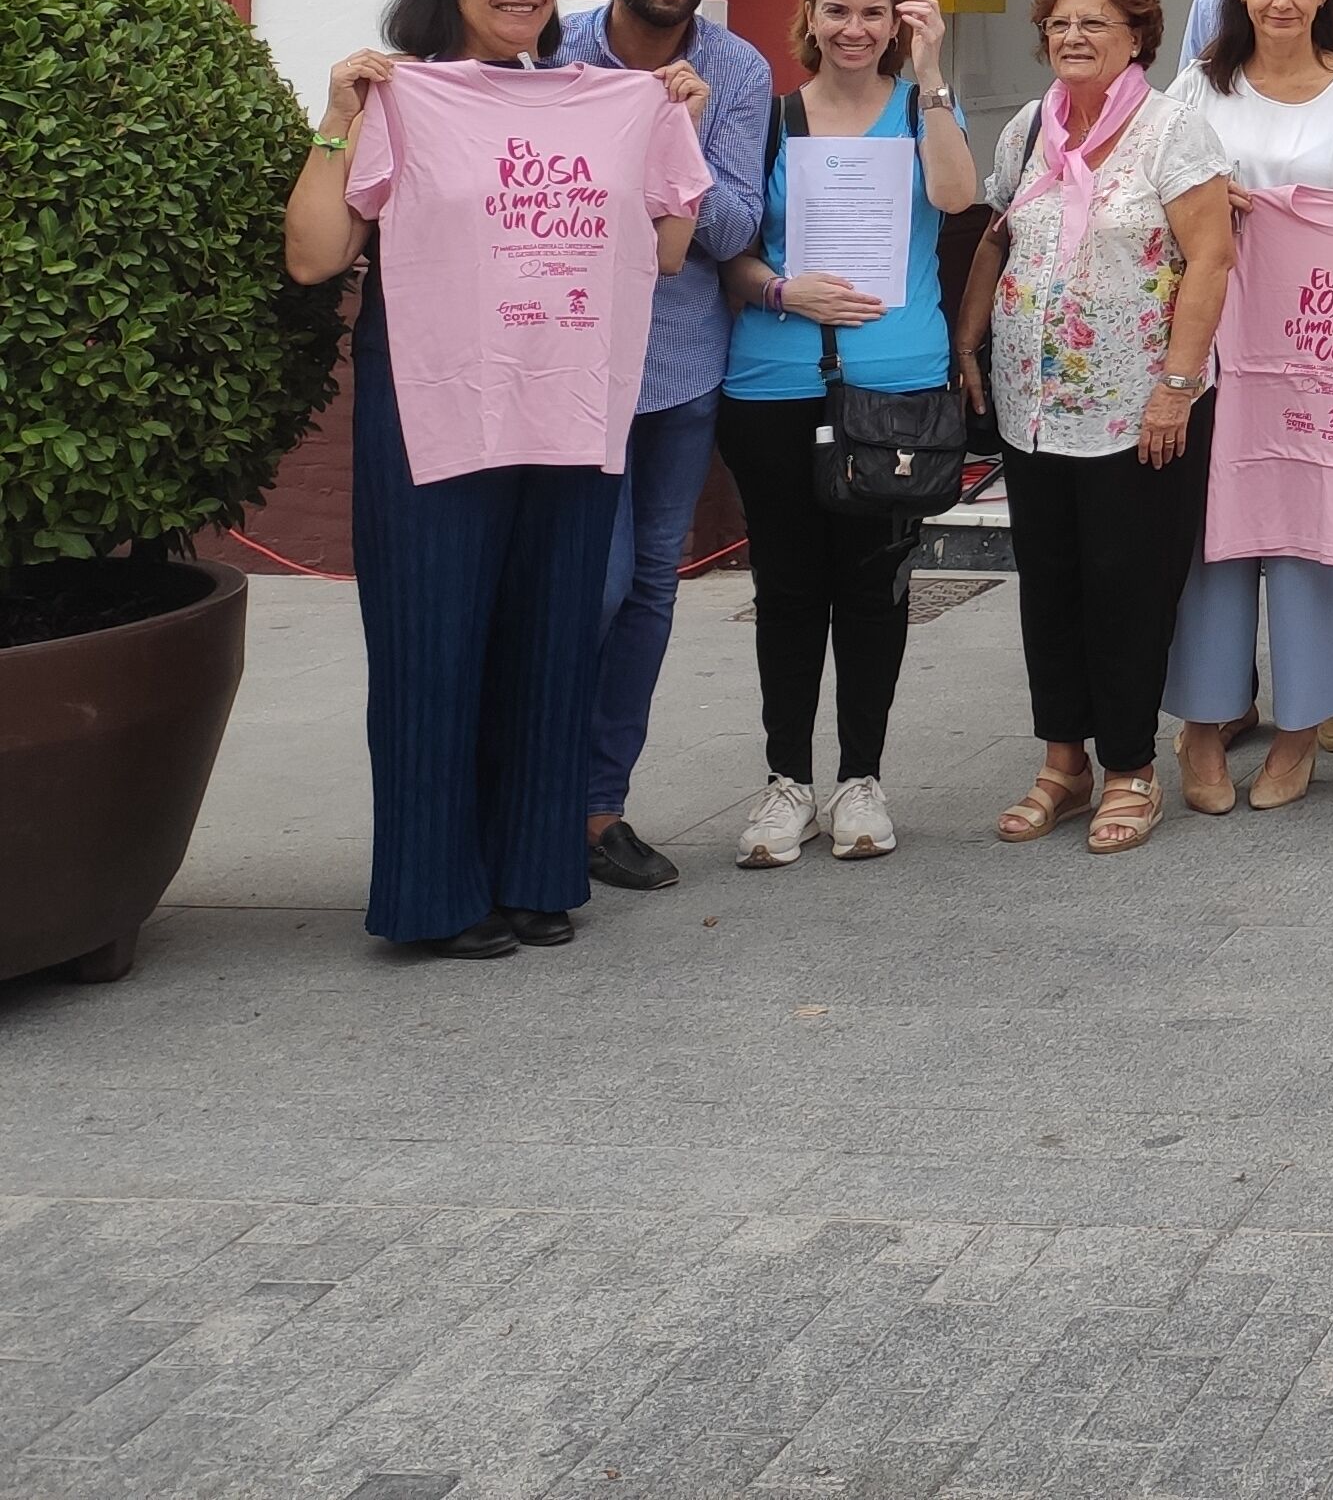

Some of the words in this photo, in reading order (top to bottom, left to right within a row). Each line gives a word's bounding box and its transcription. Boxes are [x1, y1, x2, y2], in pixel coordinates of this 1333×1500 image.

[494, 155, 592, 189] ROSA
[486, 192, 507, 216] es
[512, 184, 562, 209] más
[566, 186, 608, 208] que
[503, 211, 527, 230] un
[503, 312, 549, 322] COTREL
[1285, 317, 1302, 338] es
[1296, 334, 1312, 352] un
